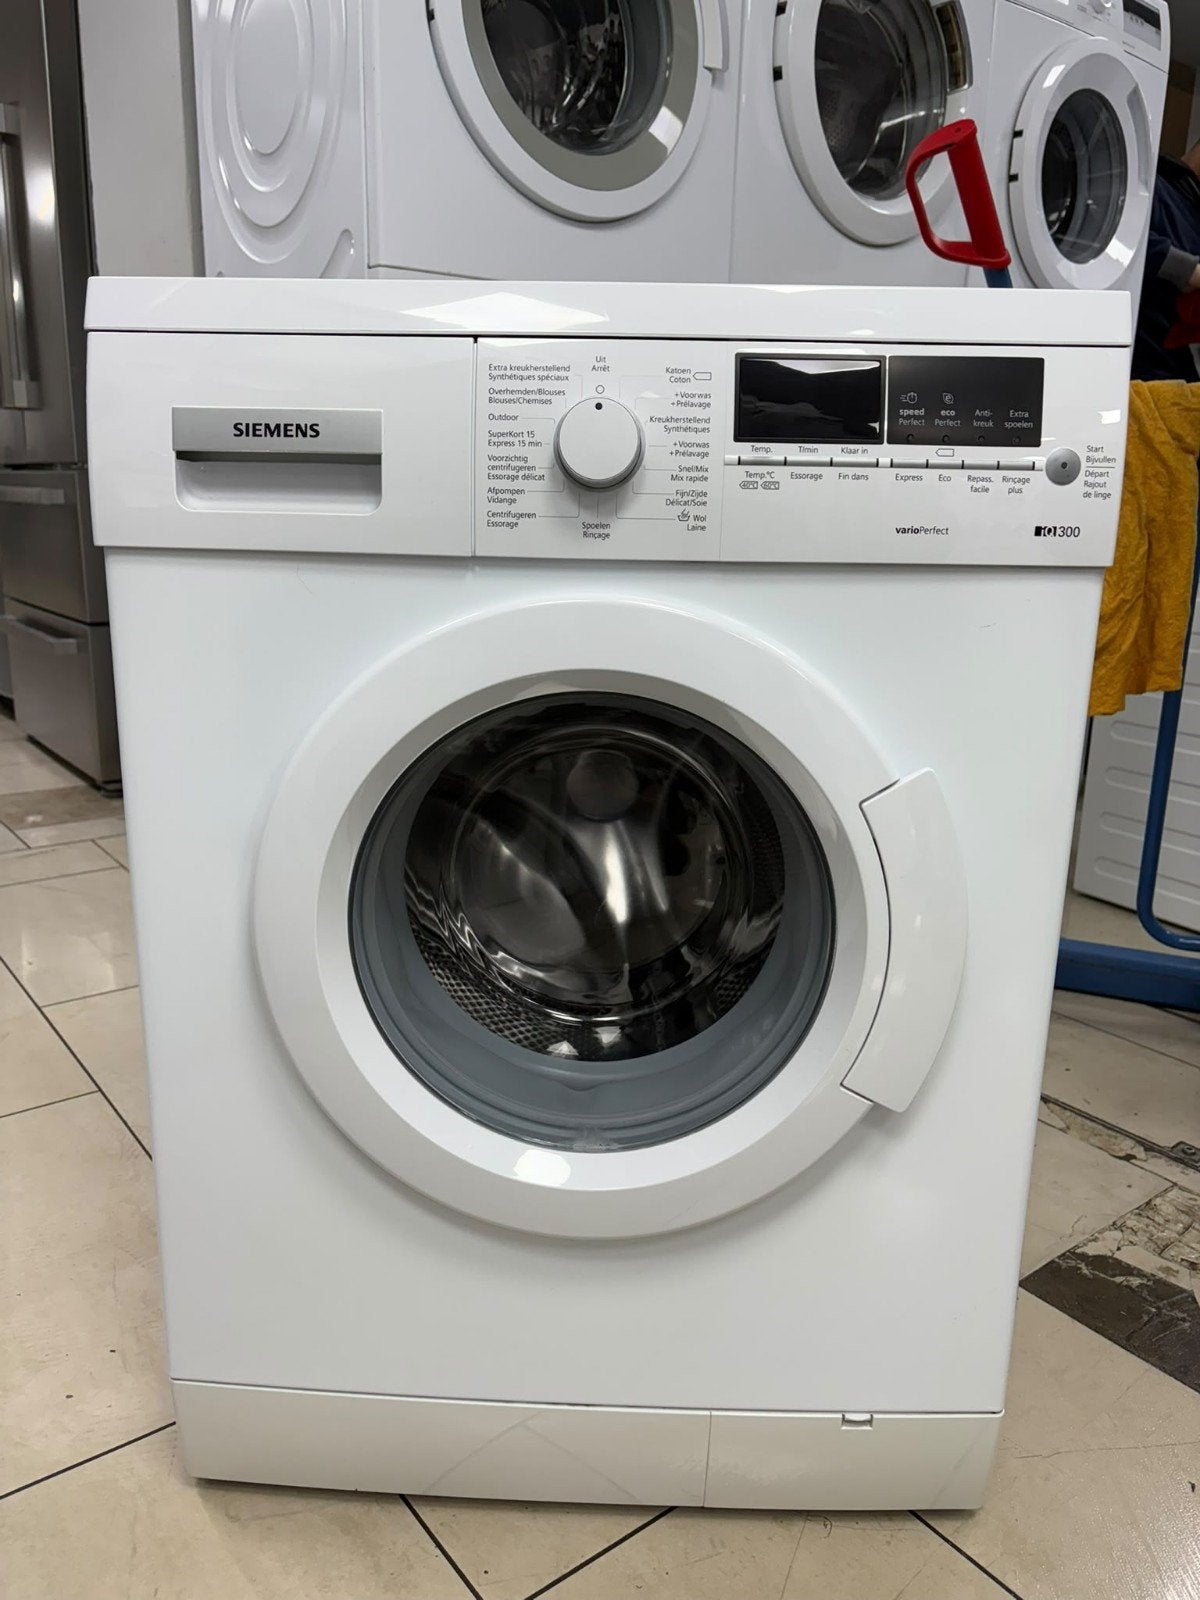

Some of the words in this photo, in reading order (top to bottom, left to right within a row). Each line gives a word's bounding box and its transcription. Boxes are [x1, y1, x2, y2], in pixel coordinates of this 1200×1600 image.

[666, 367, 691, 375] Katoen
[489, 373, 536, 381] Synthétiques
[538, 373, 569, 381] spéciaux
[488, 388, 565, 396] Overhemden/Blouses
[899, 408, 925, 417] speed
[975, 409, 993, 417] Anti-
[1010, 410, 1029, 418] Extra
[935, 419, 961, 427] Perfect
[973, 420, 994, 428] kreuk
[1004, 420, 1033, 429] spoelen
[233, 422, 320, 438] SIEMENS
[663, 426, 710, 434] Synthétiques
[751, 445, 773, 454] Temp.
[798, 446, 819, 454] T/min
[1087, 445, 1104, 453] Start
[488, 455, 528, 463] Voorzichtig
[1086, 456, 1116, 464] Bijvullen
[488, 464, 536, 472] centrifugeren
[488, 473, 519, 481] Essorage
[521, 473, 545, 481] délicat
[791, 472, 823, 480] Essorage
[851, 473, 869, 481] dans
[895, 474, 923, 482] Express
[939, 474, 951, 482] Eco
[1085, 470, 1109, 478] Départ
[686, 475, 708, 483] rapide
[967, 475, 993, 483] Repass.
[1002, 476, 1030, 485] Rinçage
[970, 485, 989, 493] facile
[1084, 481, 1107, 489] Rajout
[488, 487, 525, 495] Afpompen
[676, 490, 708, 498] Fijn/Zijde
[1008, 486, 1023, 494] plus
[488, 496, 517, 504] Vidange
[1094, 492, 1112, 500] linge
[487, 511, 536, 519] Centrifugeren
[693, 514, 707, 522] Wol
[487, 520, 518, 529] Essorage
[582, 522, 611, 530] Spoelen
[895, 526, 949, 535] varioPerfect
[582, 531, 610, 540] Rinçage
